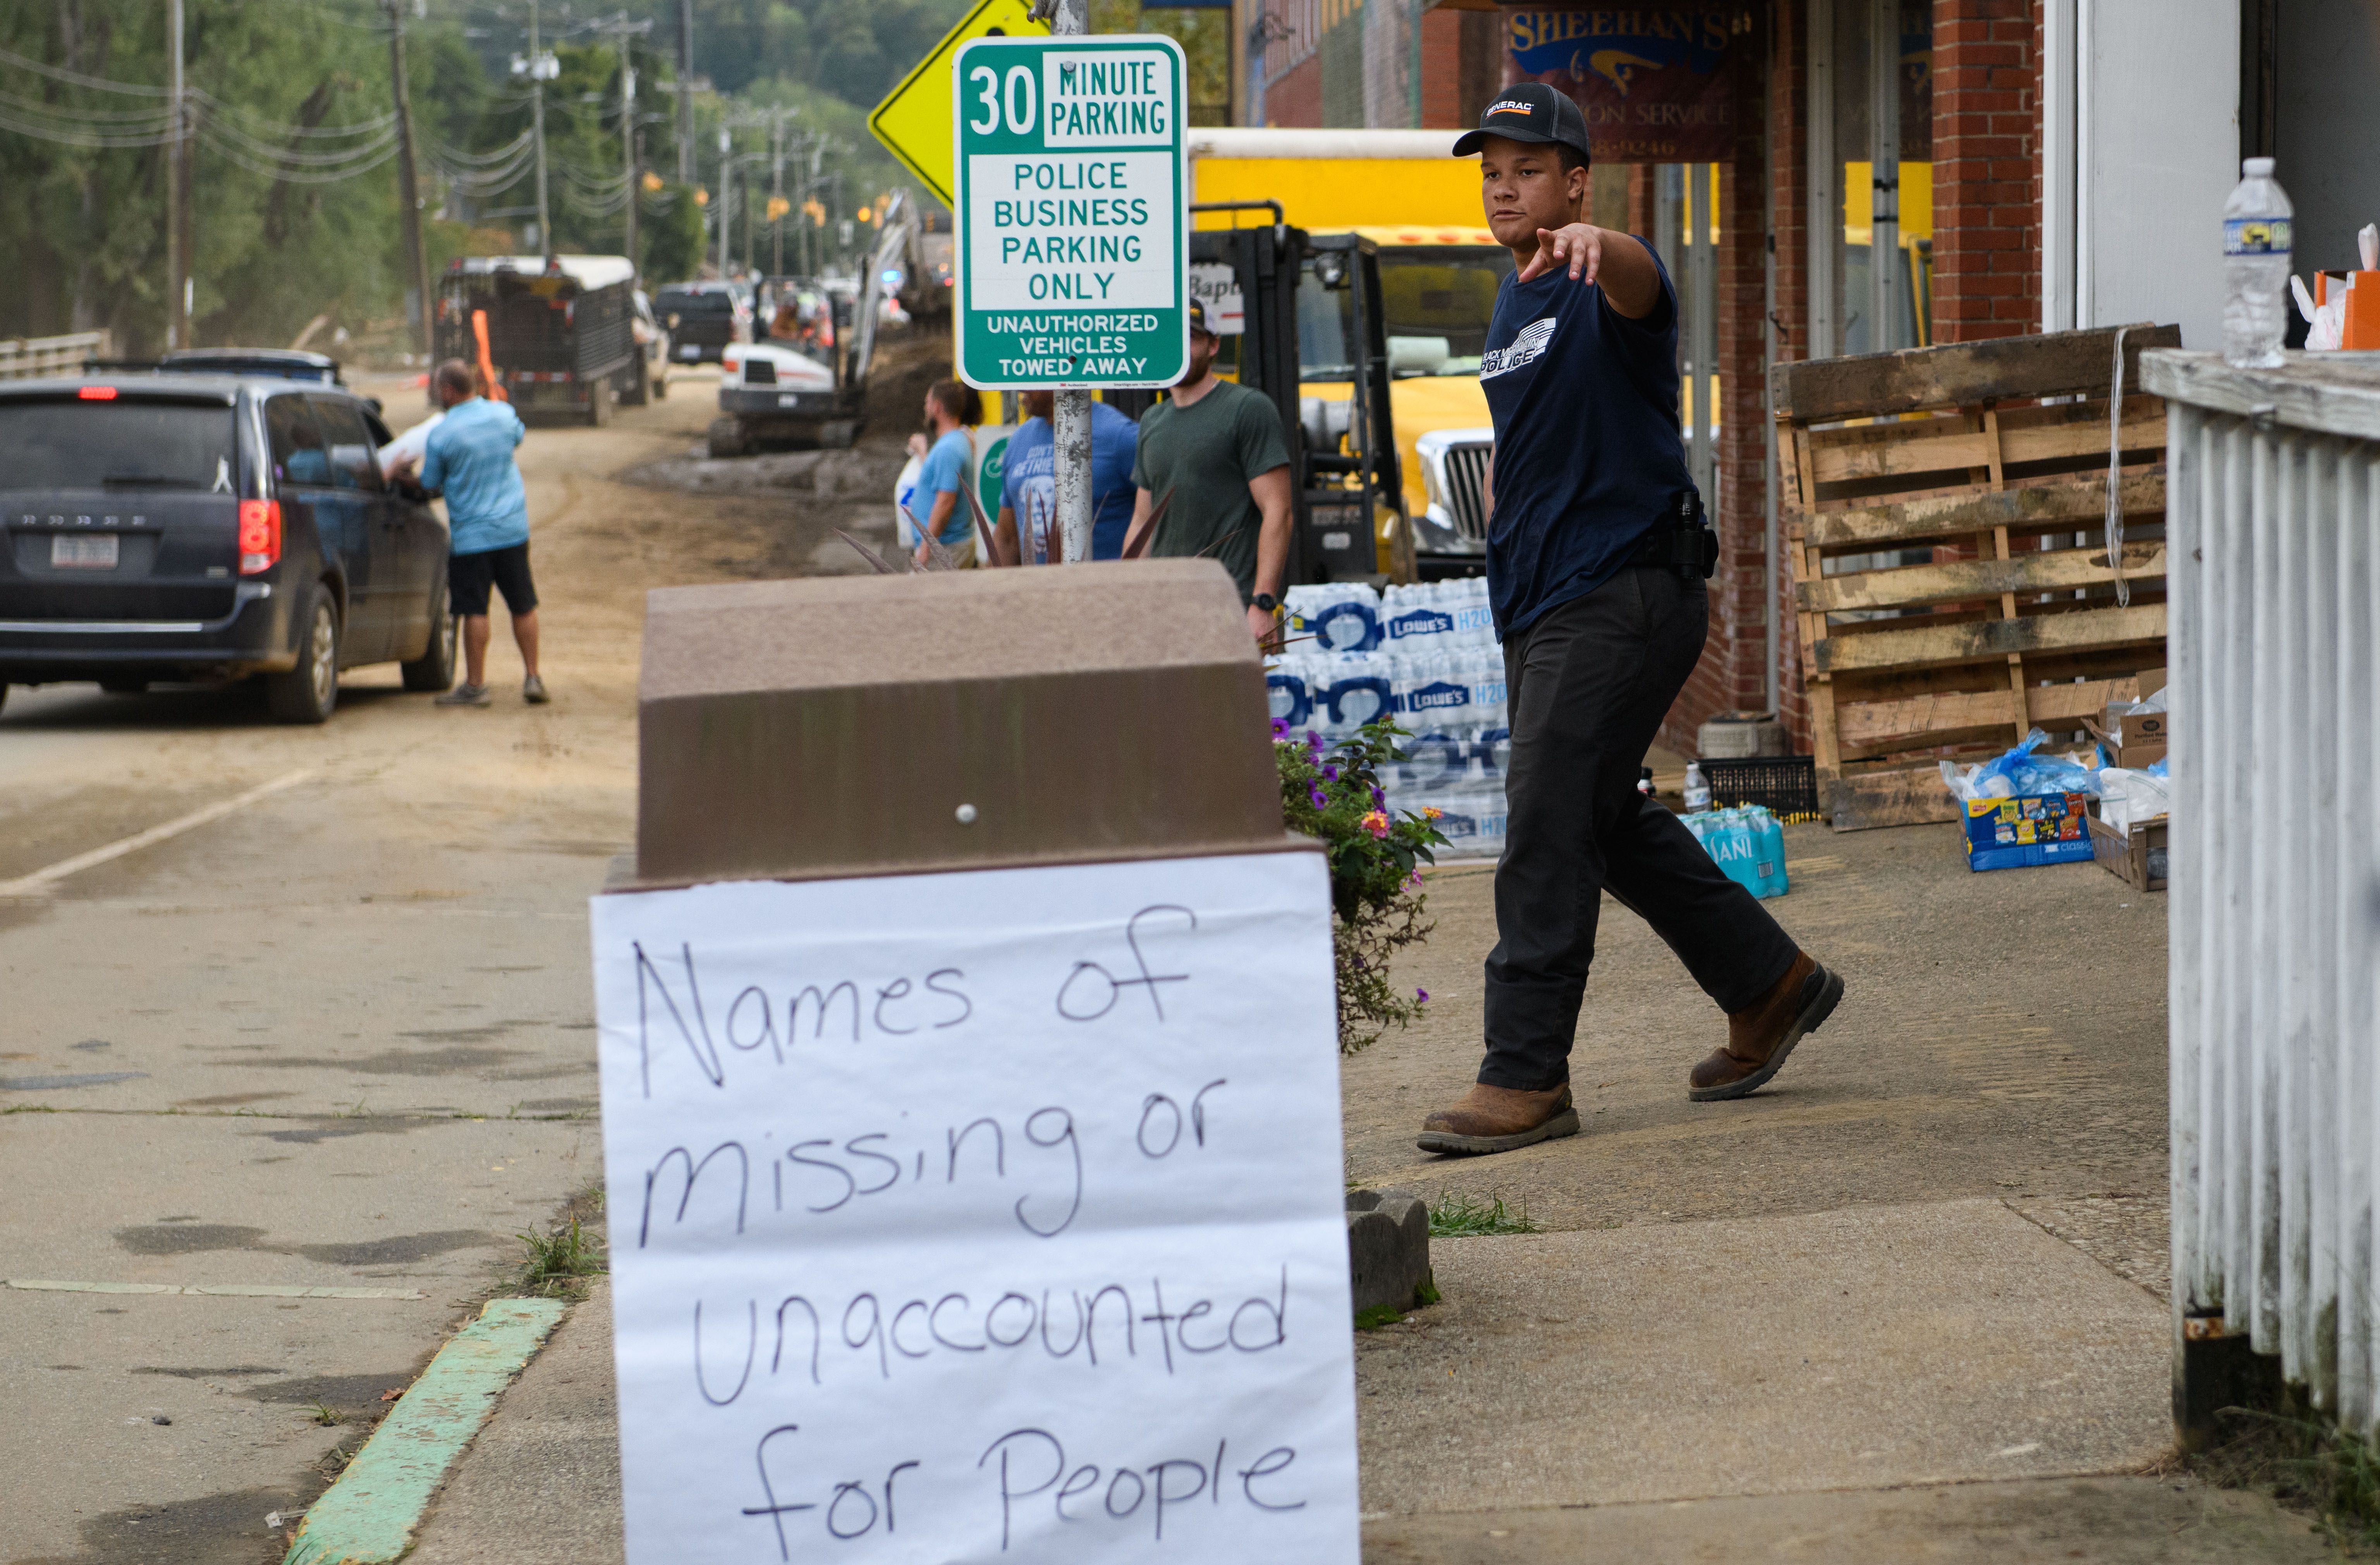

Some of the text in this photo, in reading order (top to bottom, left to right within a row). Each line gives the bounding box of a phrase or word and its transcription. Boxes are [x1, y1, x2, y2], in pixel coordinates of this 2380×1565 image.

[1509, 11, 1728, 51] SHEEHAN'S
[1060, 62, 1156, 95] MINUTE
[970, 65, 1036, 135] 30
[1487, 101, 1532, 116] GENERAC
[1052, 101, 1164, 136] PARKING
[1636, 104, 1729, 125] SERVICE
[1015, 162, 1127, 190] POLICE
[995, 198, 1148, 227] BUSINESS
[1003, 236, 1141, 264] PARKING
[1029, 272, 1115, 300] ONLY
[987, 315, 1158, 334] UNAUTHORIZED
[1019, 336, 1127, 355] VEHICLES
[999, 358, 1147, 376] TOWED AWAY
[1480, 347, 1537, 373] POLICE
[1394, 617, 1447, 636] LOWE'S
[1414, 690, 1464, 709] LOWE'S
[631, 904, 1197, 1099] Names of
[1136, 1079, 1227, 1159] or
[742, 1425, 1307, 1562] for People
